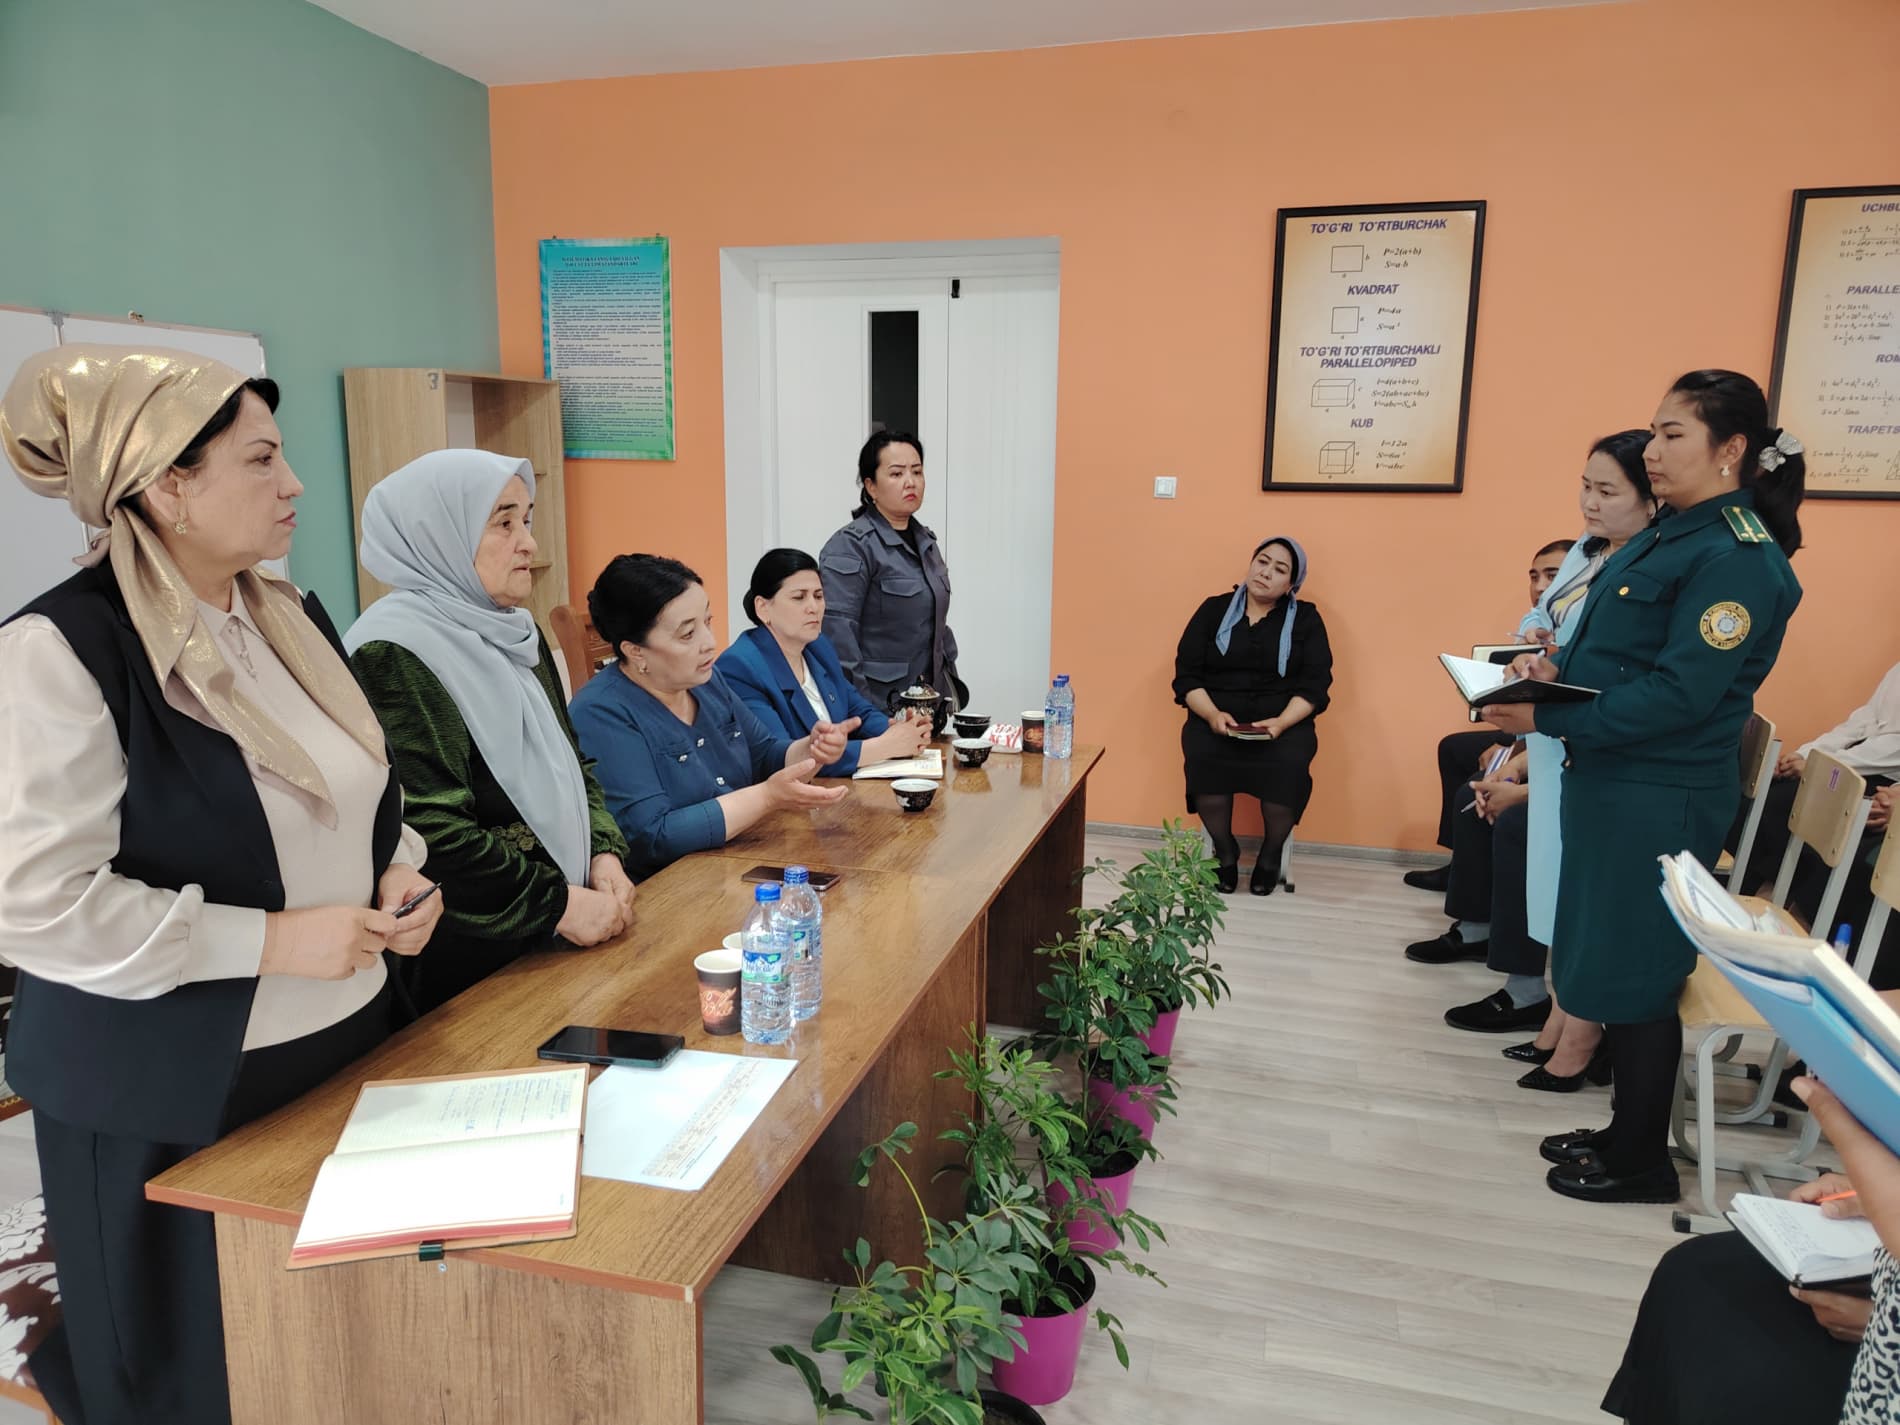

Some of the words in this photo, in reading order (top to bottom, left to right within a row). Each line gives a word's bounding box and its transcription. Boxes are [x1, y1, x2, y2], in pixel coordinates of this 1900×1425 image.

[1359, 218, 1448, 232] TO'RTBURCHAK
[1347, 284, 1400, 296] KVADRAT
[1320, 356, 1418, 369] PARALLELOPIPED
[1350, 418, 1374, 429] KUB
